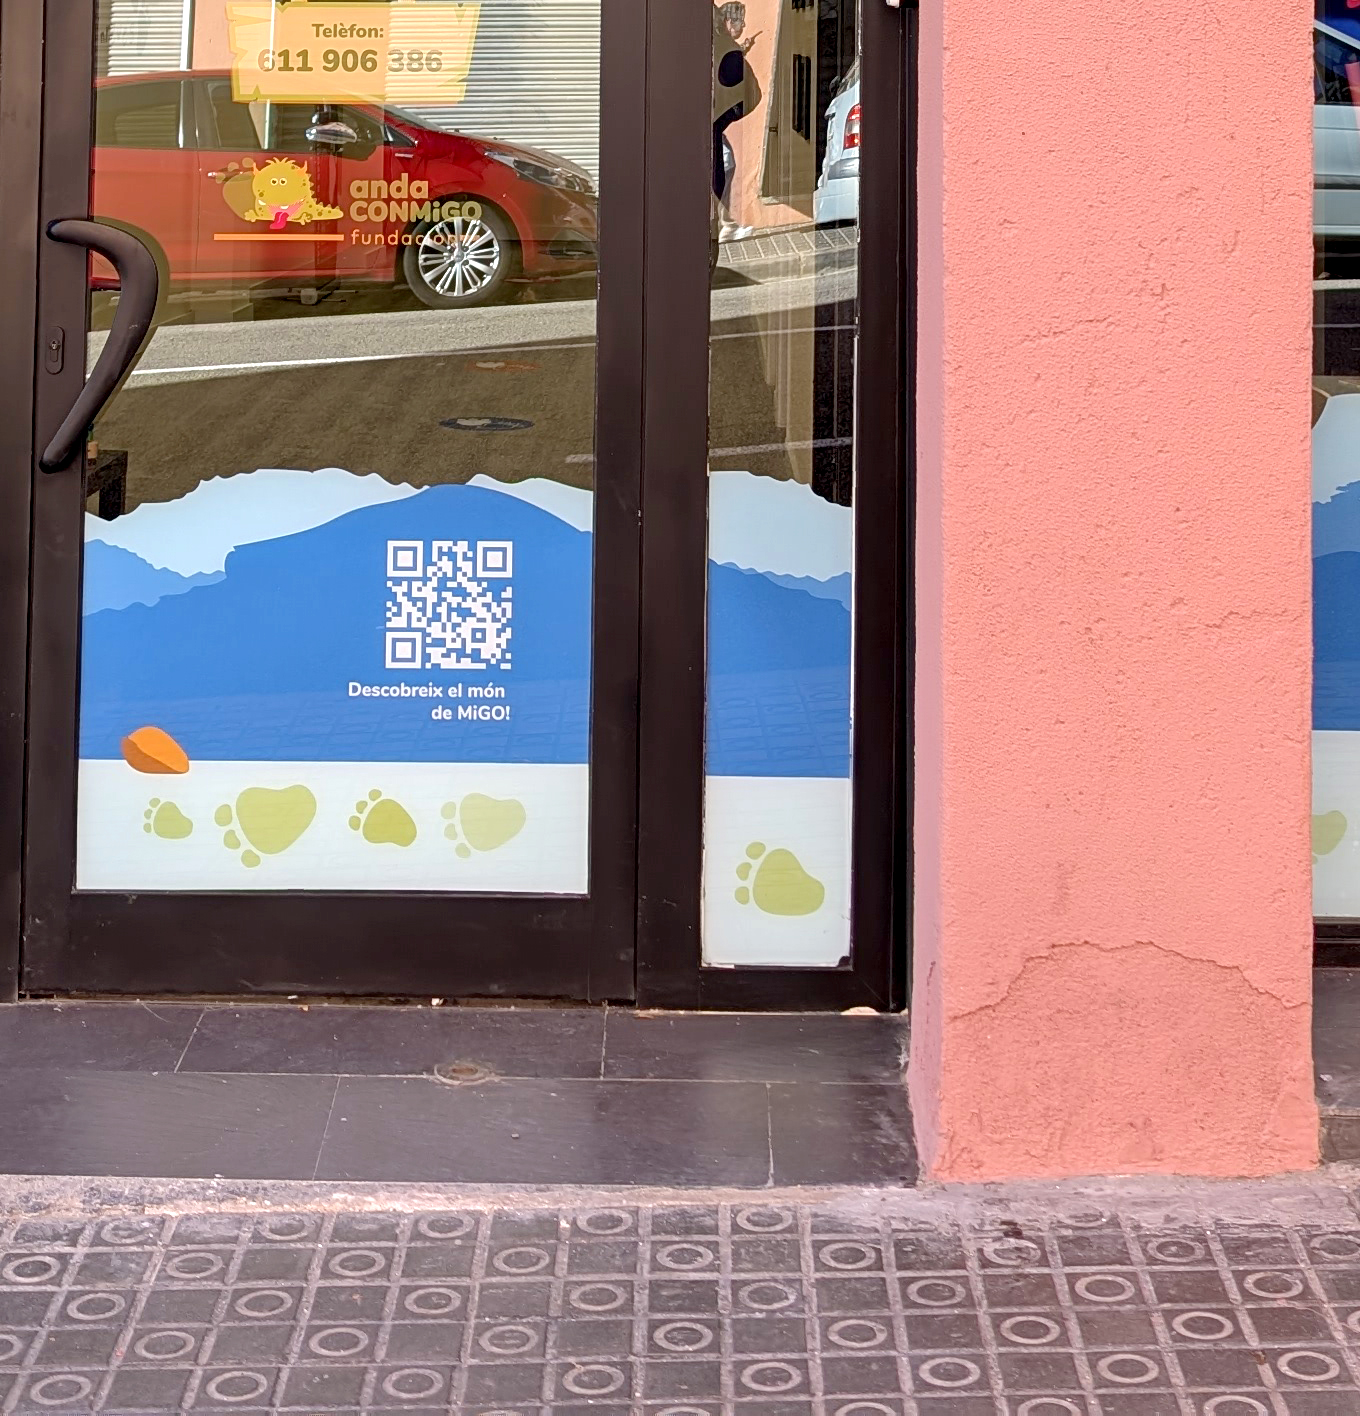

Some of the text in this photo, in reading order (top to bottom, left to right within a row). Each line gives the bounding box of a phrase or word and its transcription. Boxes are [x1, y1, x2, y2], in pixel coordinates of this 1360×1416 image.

[311, 23, 384, 38] Telèfon:
[258, 49, 443, 72] 611 906 386
[350, 172, 429, 199] anda
[350, 200, 483, 223] CONMiGO
[348, 682, 505, 698] Descobreix el món
[431, 705, 510, 720] de MiGO!
